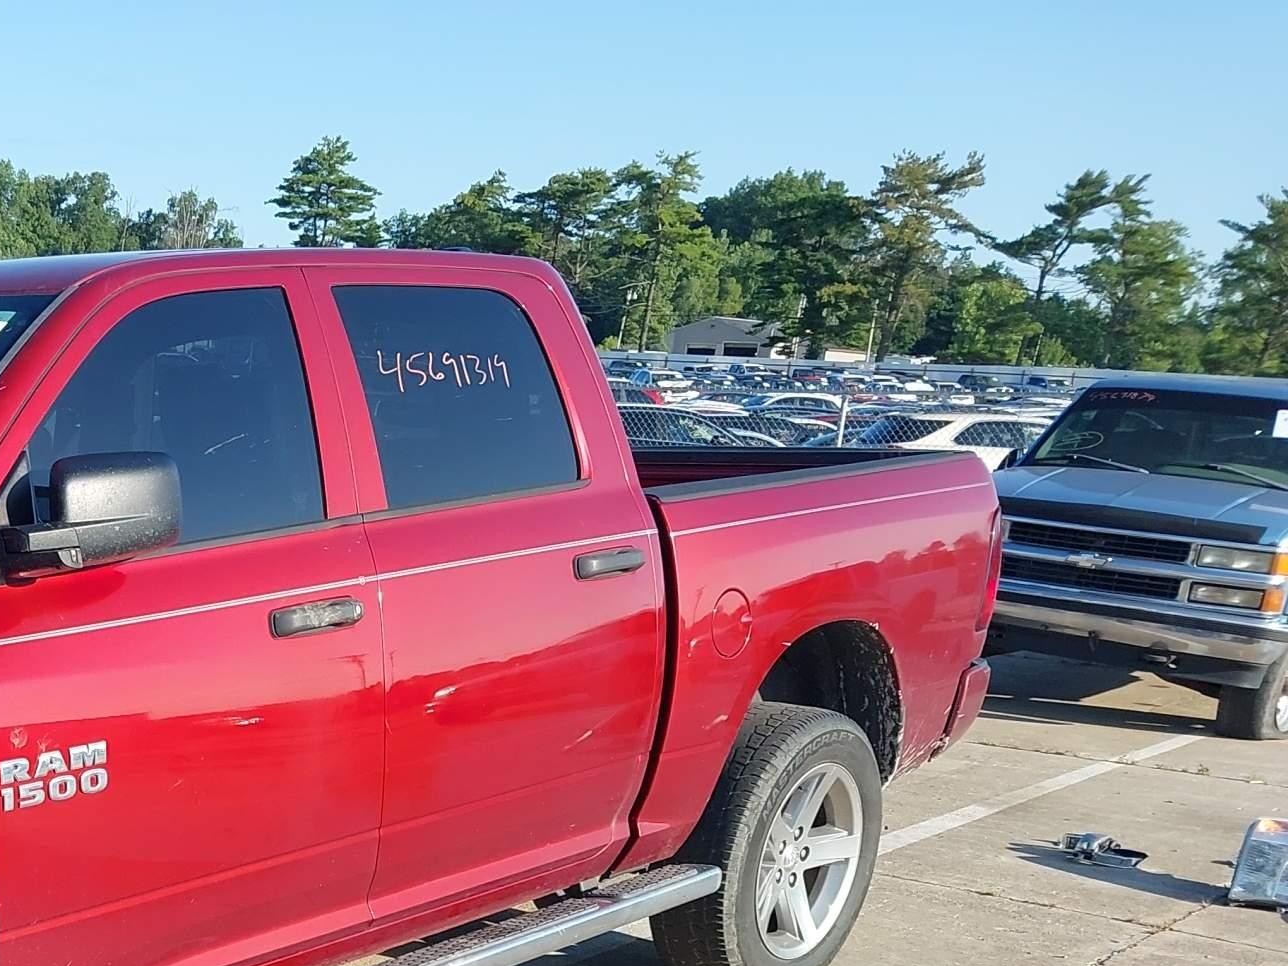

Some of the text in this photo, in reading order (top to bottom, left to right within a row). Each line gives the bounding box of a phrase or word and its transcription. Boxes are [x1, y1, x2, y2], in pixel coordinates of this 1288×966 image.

[376, 350, 511, 393] 45691319
[0, 739, 108, 785] RAM
[0, 767, 109, 812] 1500
